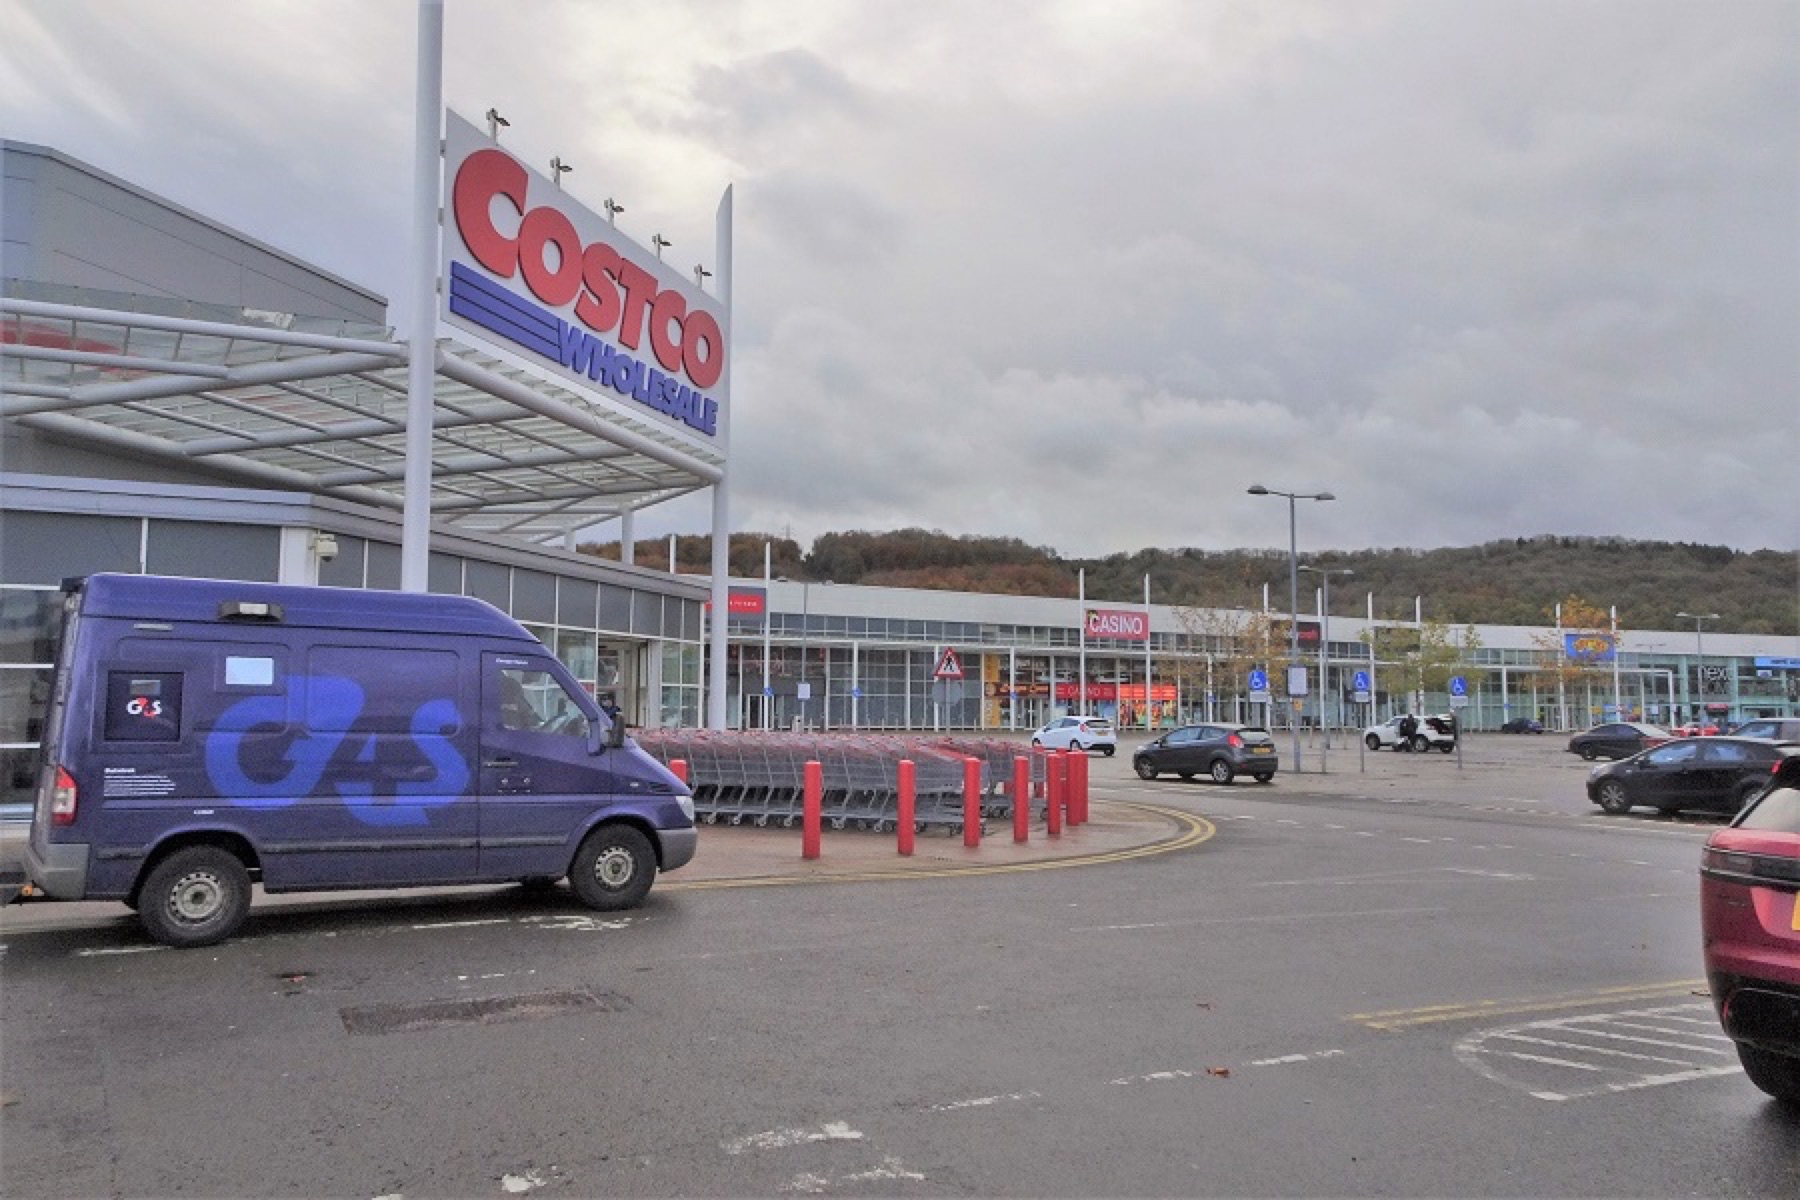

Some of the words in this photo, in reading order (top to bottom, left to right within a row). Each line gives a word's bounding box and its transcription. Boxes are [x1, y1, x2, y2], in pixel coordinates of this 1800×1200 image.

[453, 148, 723, 388] COSTCO
[557, 318, 718, 436] WHOLESALE
[1089, 613, 1143, 635] CASINO
[126, 697, 163, 718] G4S
[1067, 685, 1101, 697] CANO
[205, 674, 470, 826] G4S
